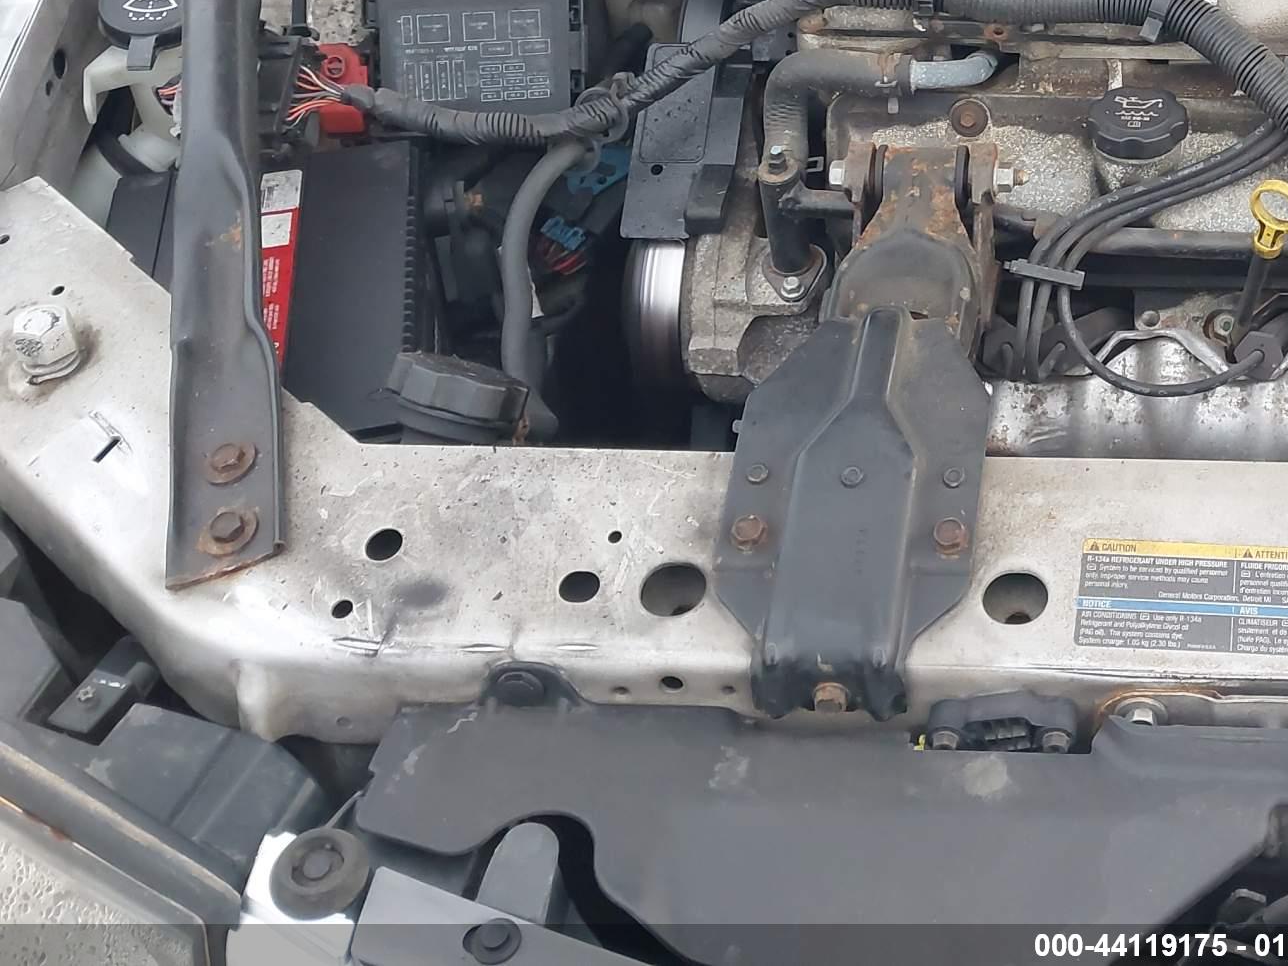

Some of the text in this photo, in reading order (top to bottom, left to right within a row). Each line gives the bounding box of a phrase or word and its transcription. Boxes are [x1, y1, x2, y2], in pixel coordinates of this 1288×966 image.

[1102, 543, 1136, 552] CAUTION
[1111, 556, 1153, 565] REFRIGERANT
[1155, 558, 1177, 566] UNDER
[1195, 560, 1227, 568] PRESSURE
[1082, 599, 1111, 608] NOTICE
